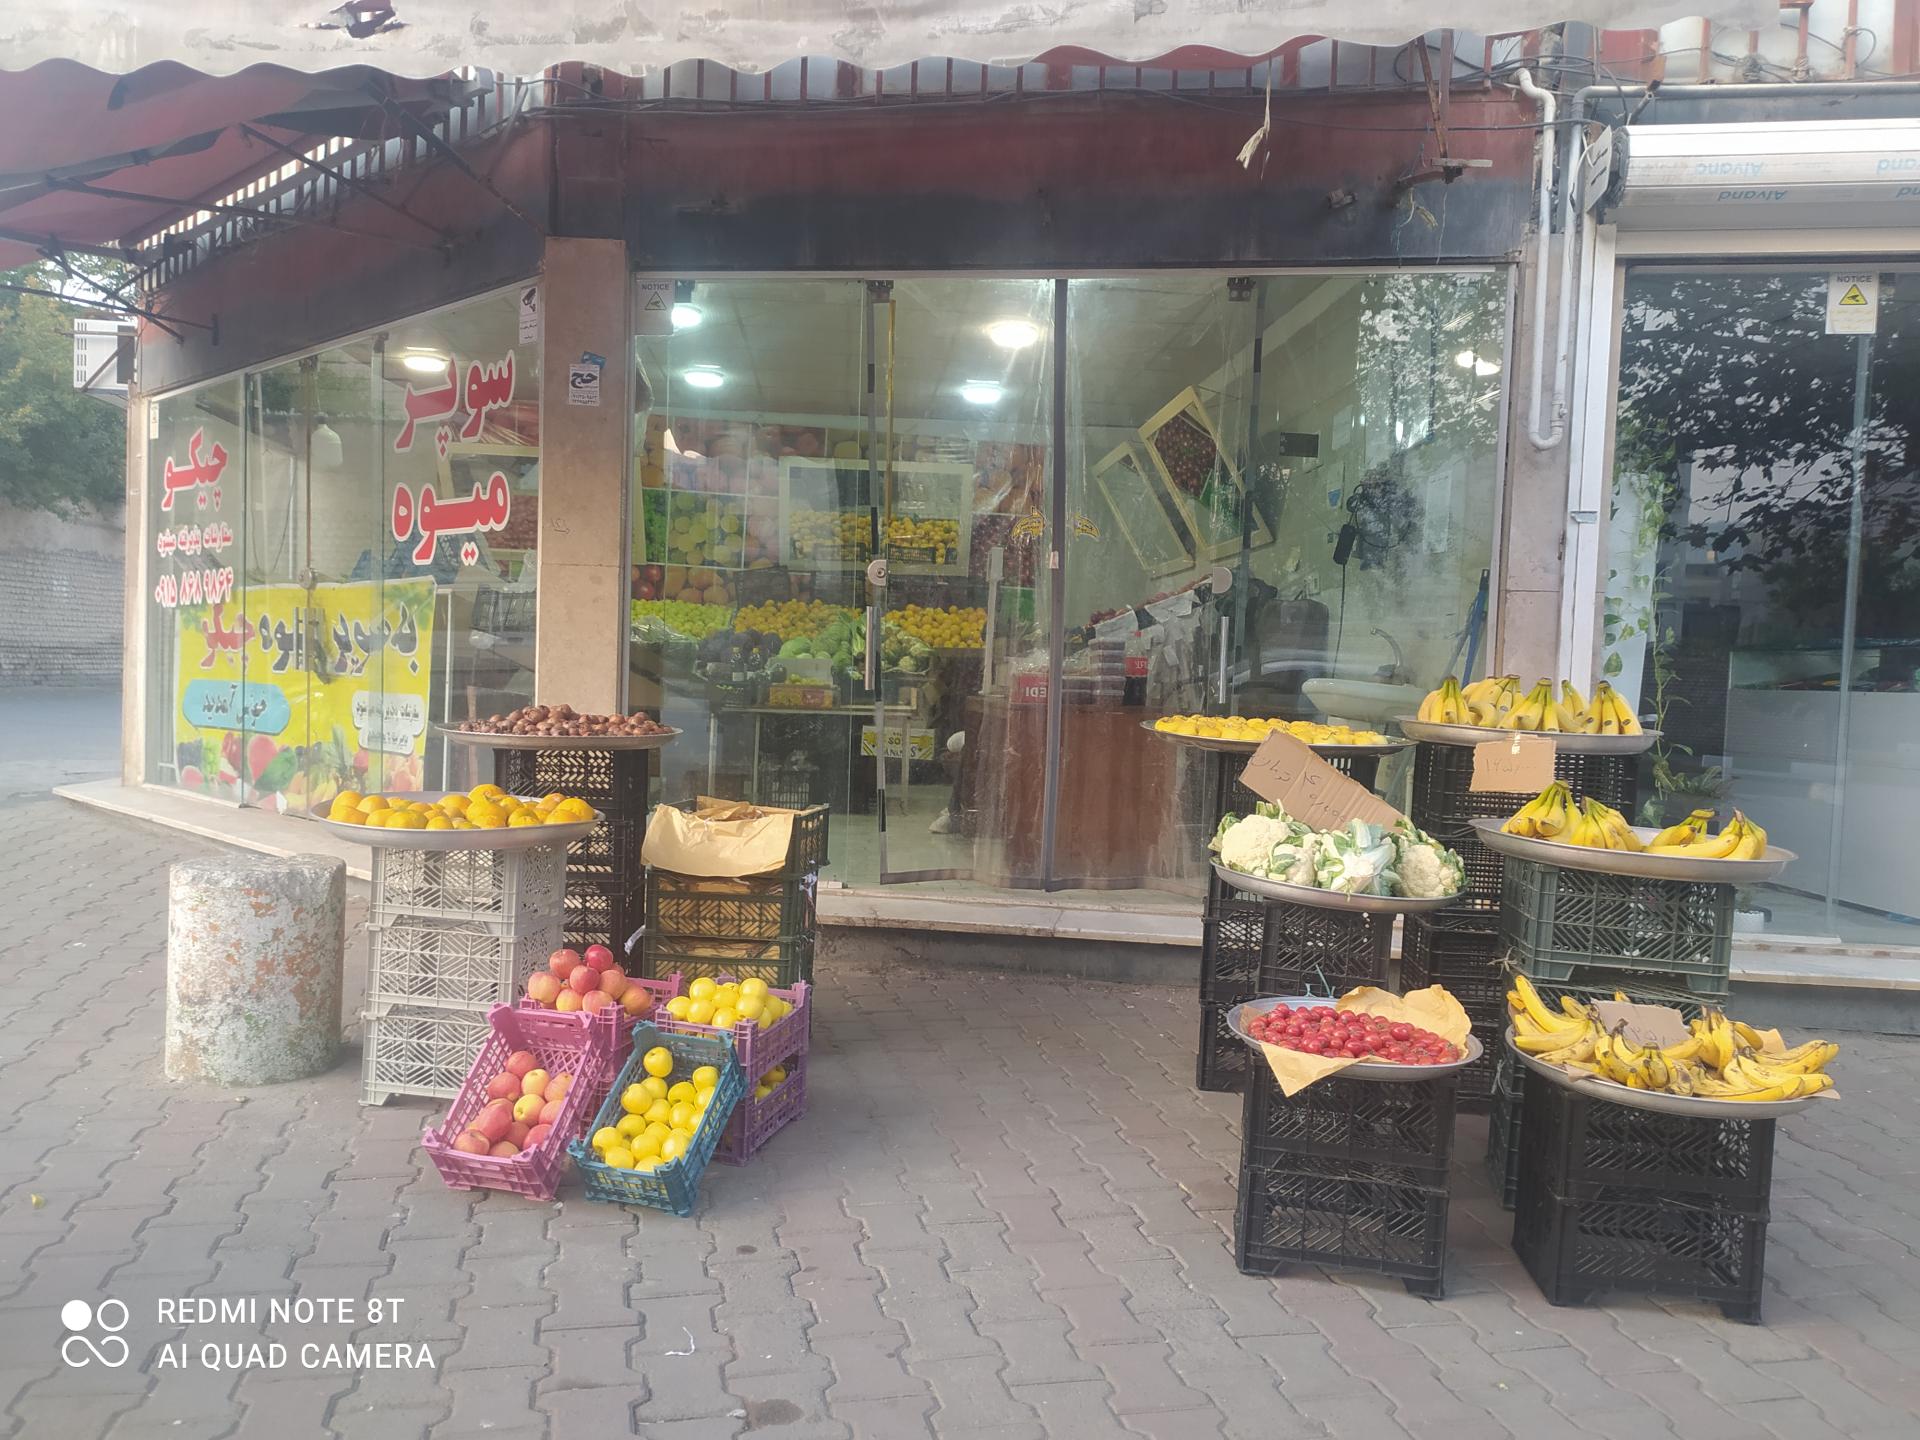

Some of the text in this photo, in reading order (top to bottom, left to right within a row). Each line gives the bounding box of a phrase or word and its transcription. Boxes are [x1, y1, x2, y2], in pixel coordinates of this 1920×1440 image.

[1695, 161, 1763, 176] Alvand
[1717, 189, 1789, 201] Alvand
[641, 283, 670, 291] NOTICE
[395, 349, 516, 459] سوپر
[161, 426, 229, 512] چیکو
[392, 471, 512, 567] میوه
